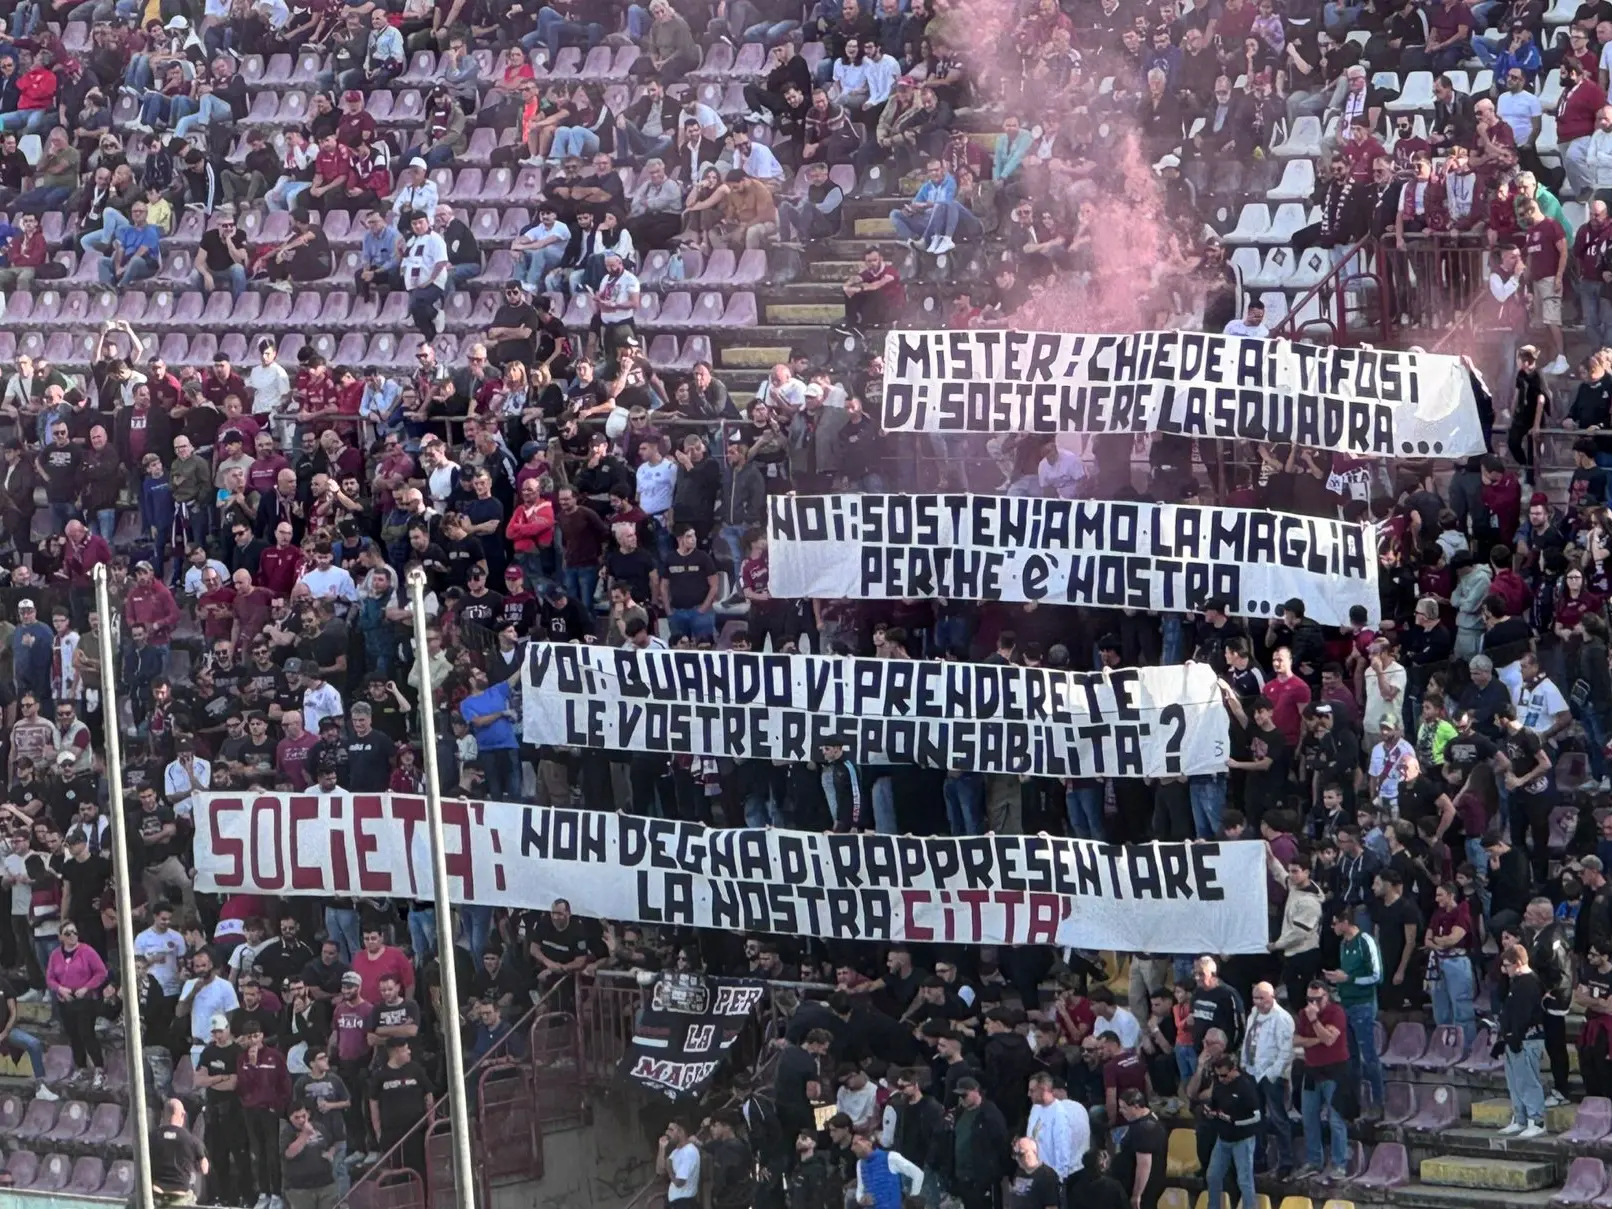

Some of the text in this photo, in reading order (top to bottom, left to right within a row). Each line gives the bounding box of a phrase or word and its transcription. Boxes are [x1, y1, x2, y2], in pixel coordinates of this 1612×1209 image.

[938, 382, 1153, 432] SOSTENERE
[1156, 384, 1207, 435] LA
[1151, 506, 1201, 558] LA
[614, 649, 793, 708] QUANDO
[854, 659, 1141, 724] PRENDERETE
[566, 699, 606, 746] LE
[618, 701, 770, 755] VOSTRE
[521, 807, 606, 863] NON
[618, 816, 772, 879] DEGNA
[828, 834, 1224, 901] RAPPRESENTARE
[637, 870, 694, 924] LA
[708, 878, 891, 939] NOSTRA
[713, 986, 763, 1015] PER
[683, 1024, 716, 1052] LA
